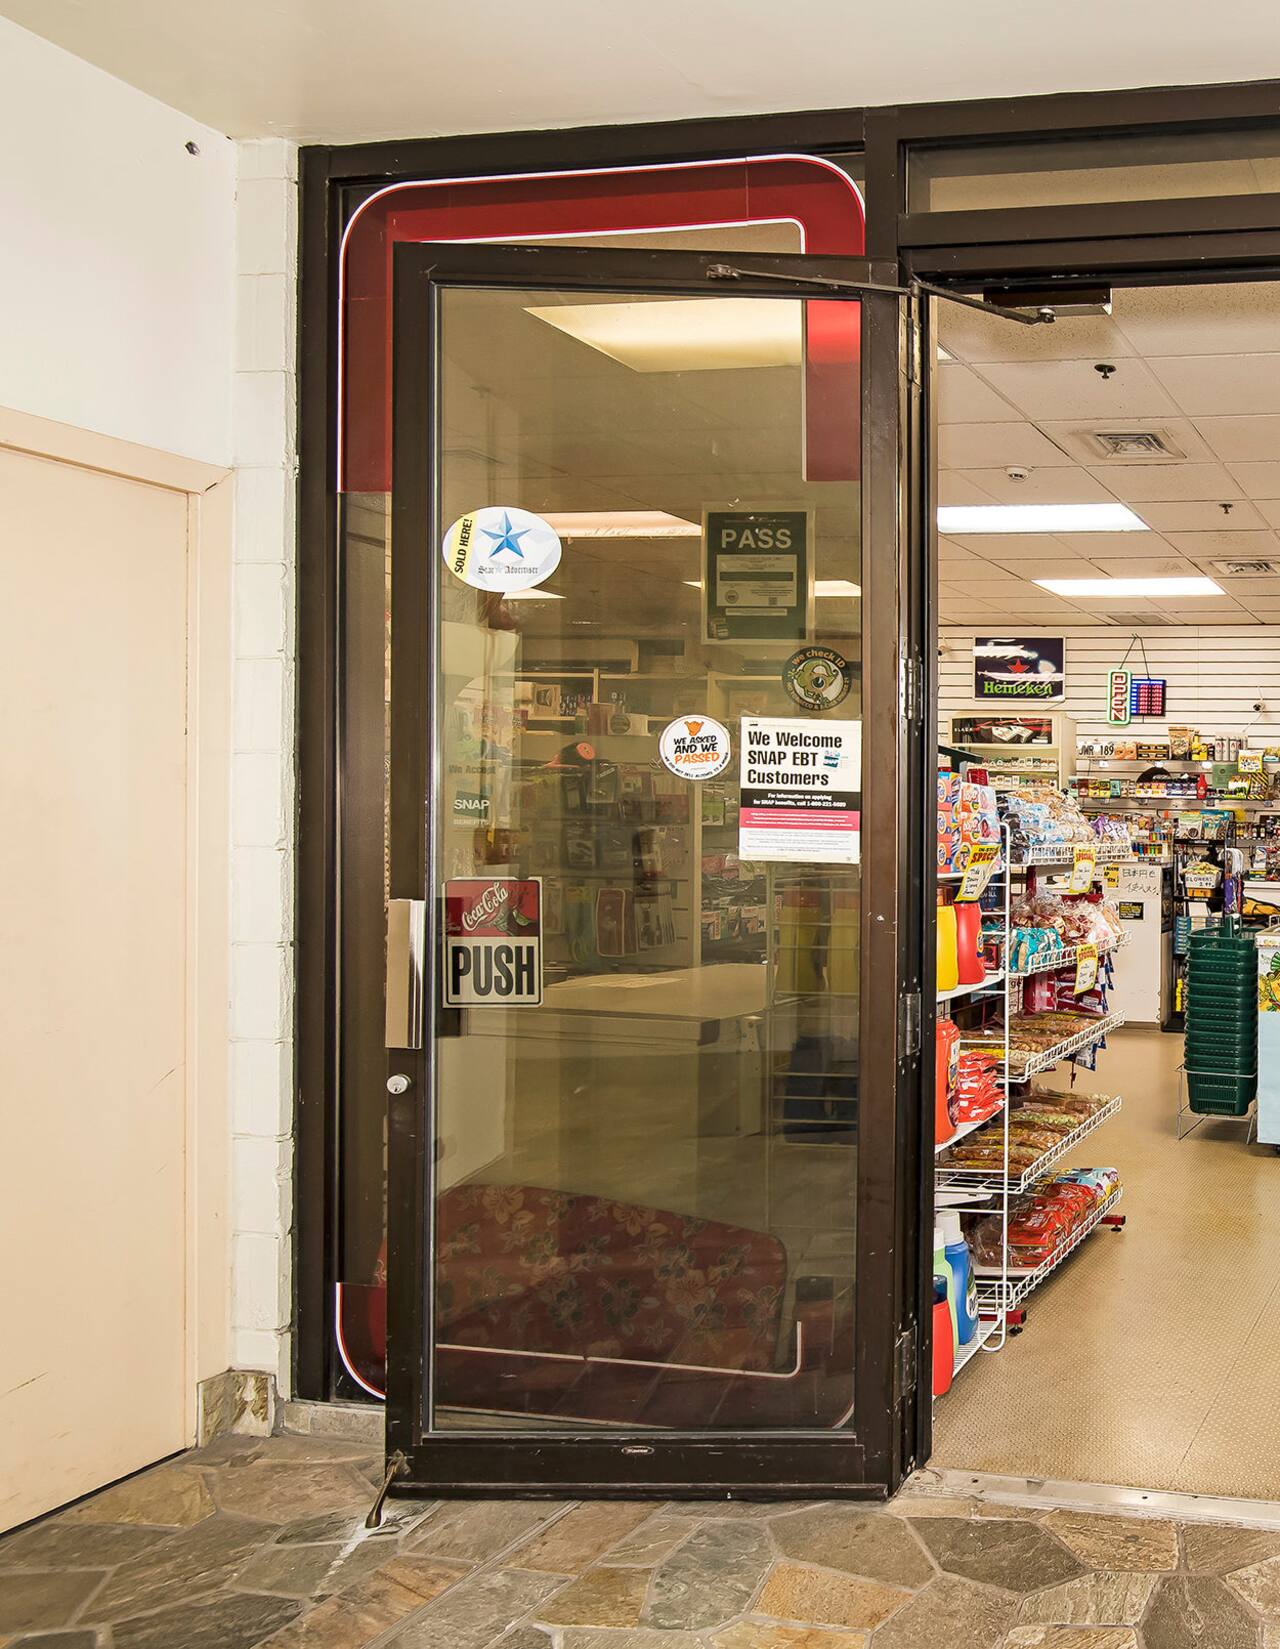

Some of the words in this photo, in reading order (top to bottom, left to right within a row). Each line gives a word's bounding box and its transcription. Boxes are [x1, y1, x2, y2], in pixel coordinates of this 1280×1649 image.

[459, 518, 473, 547] HERE!
[721, 528, 792, 549] PASS
[454, 549, 467, 574] SOLD
[791, 654, 805, 665] We
[806, 649, 835, 661] check
[835, 657, 846, 668] ID
[983, 680, 1053, 697] Heineken
[1110, 672, 1127, 721] OPEN
[674, 737, 687, 745] WE
[689, 735, 717, 744] ASKED
[674, 744, 697, 754] AND
[701, 742, 718, 752] WE
[748, 731, 770, 745] We
[776, 731, 843, 748] Welcome
[675, 752, 720, 765] PASSED
[747, 750, 787, 766] SNAP
[792, 752, 818, 766] EBT
[747, 769, 829, 786] Customers
[453, 799, 490, 810] SNAP
[452, 945, 535, 996] PUSH
